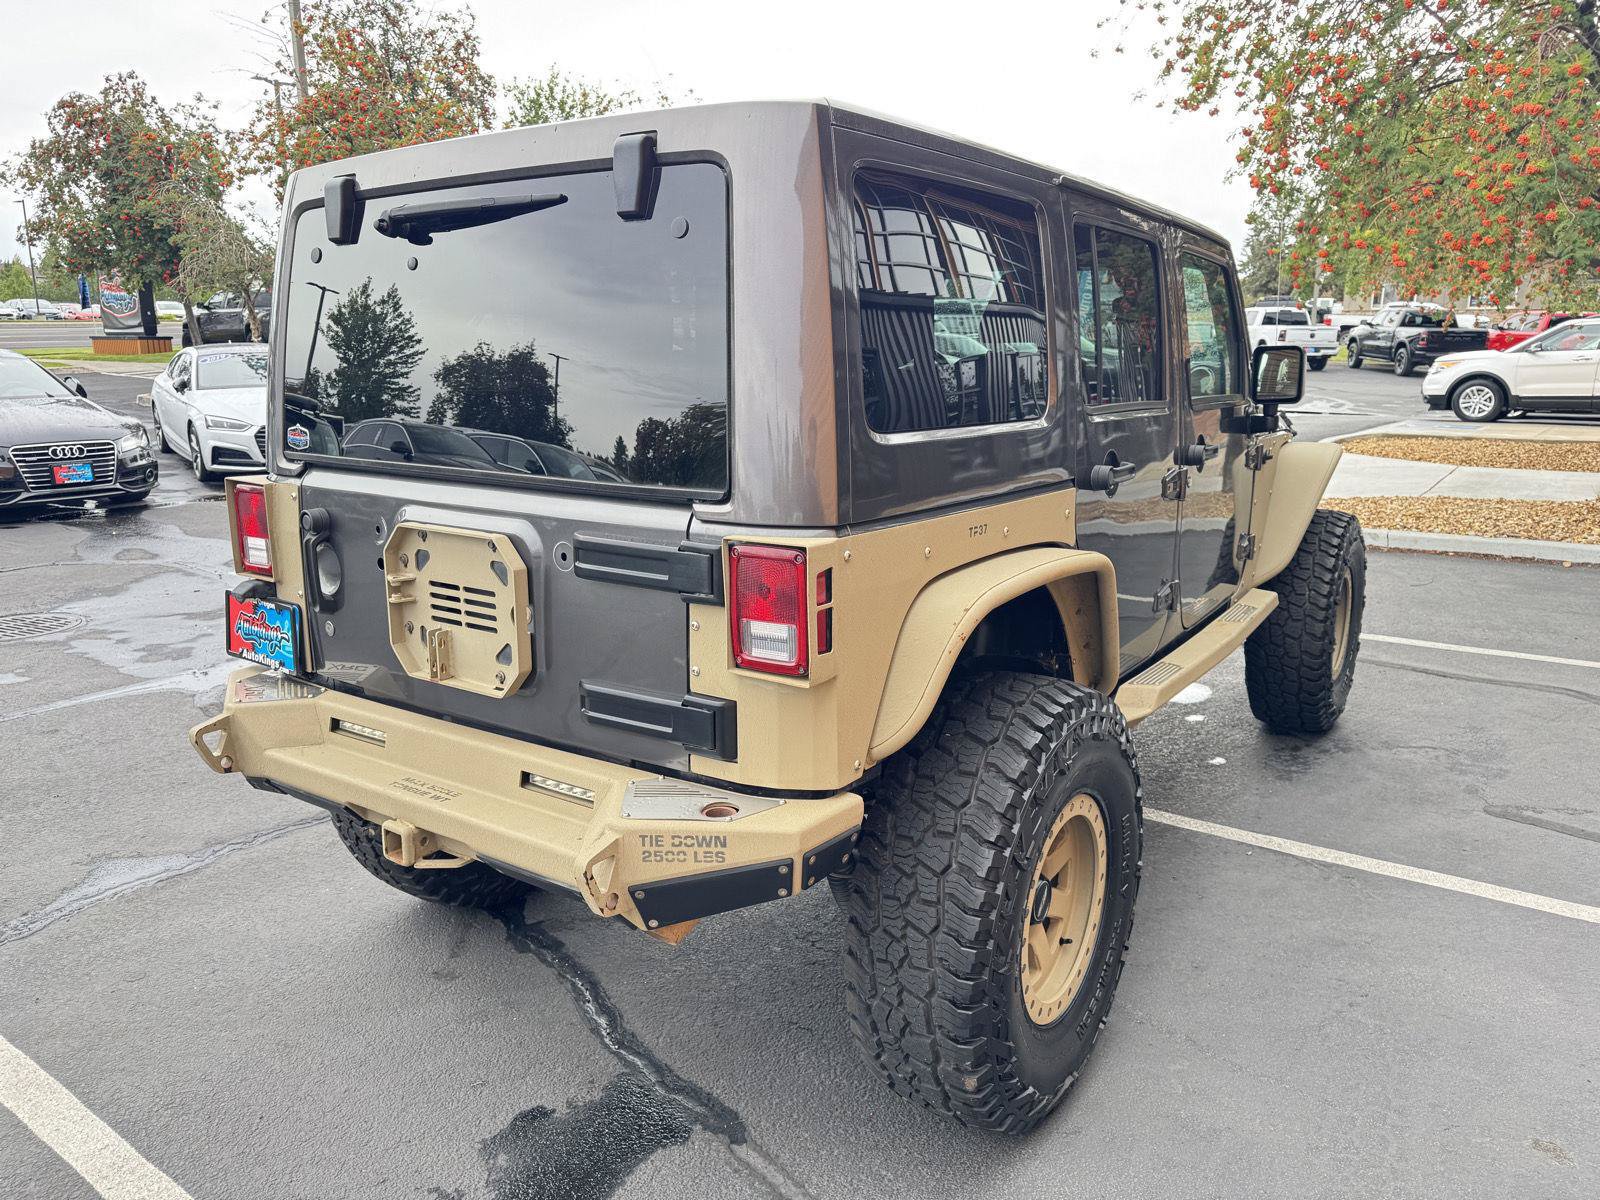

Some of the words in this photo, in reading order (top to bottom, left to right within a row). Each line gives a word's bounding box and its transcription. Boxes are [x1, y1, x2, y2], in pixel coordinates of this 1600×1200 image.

[968, 523, 988, 538] TF37
[242, 648, 280, 669] AutoKings
[639, 834, 665, 848] TIE
[671, 834, 727, 849] DOWN
[641, 850, 688, 863] 2500
